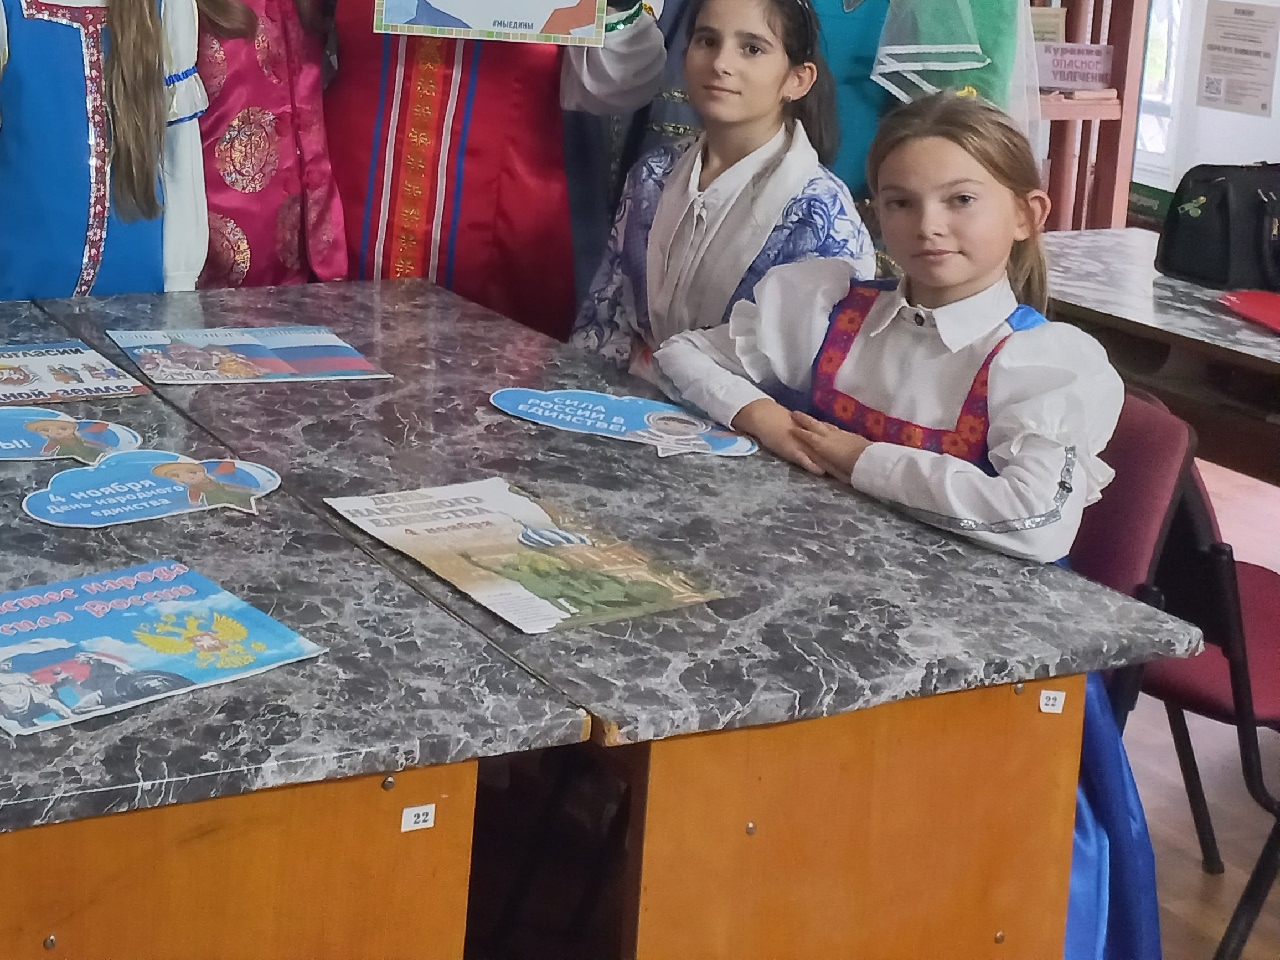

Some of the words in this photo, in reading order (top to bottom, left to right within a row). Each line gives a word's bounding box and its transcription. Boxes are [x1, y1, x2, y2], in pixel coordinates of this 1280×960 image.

[492, 20, 534, 30] #МЫЕДИНЫ
[55, 384, 133, 398] земле
[527, 398, 606, 421] РОССИИ
[612, 416, 624, 424] В
[553, 397, 606, 412] СИЛА
[517, 404, 627, 433] ЕДИНСТВЕ!
[46, 500, 92, 515] День
[95, 485, 185, 506] народного
[49, 492, 66, 503] 4
[70, 478, 157, 500] ноября
[90, 498, 172, 518] единства
[81, 563, 190, 595] народа
[75, 584, 198, 619] России
[1044, 695, 1058, 707] 22
[413, 811, 430, 825] 22
